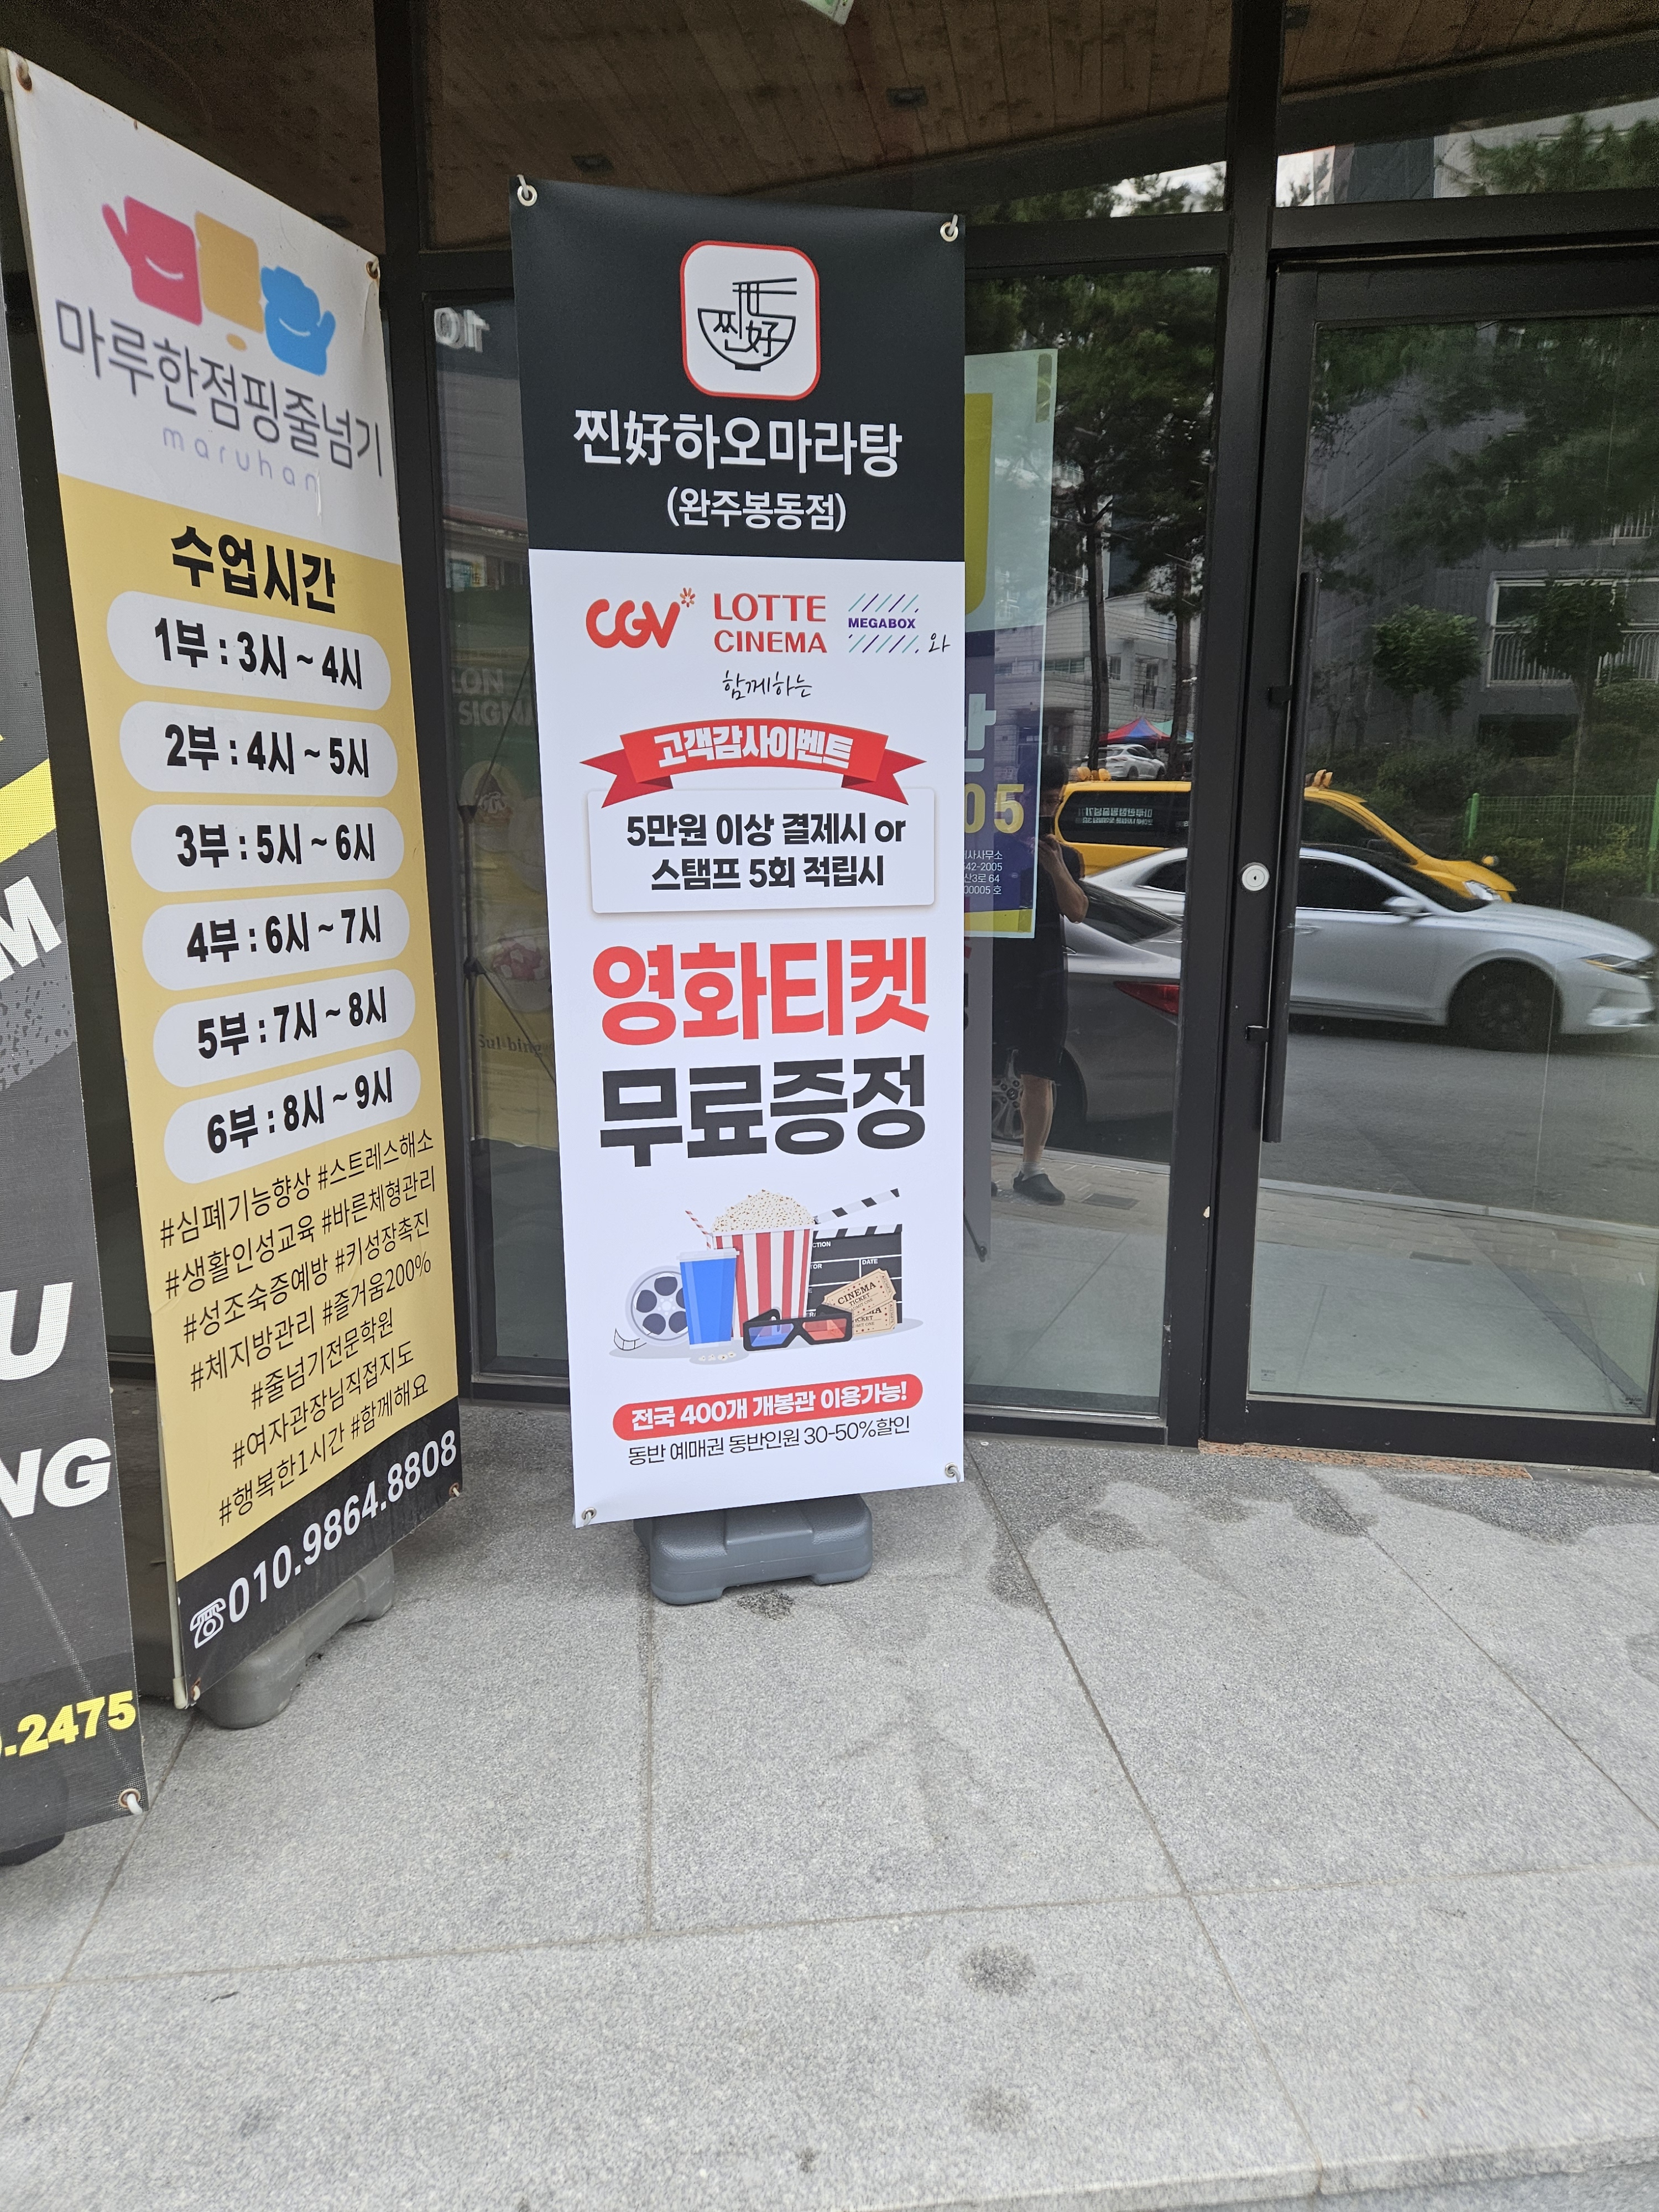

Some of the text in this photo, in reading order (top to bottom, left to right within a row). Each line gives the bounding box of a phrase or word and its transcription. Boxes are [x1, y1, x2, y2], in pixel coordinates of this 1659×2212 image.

[55, 299, 383, 478] 마루한점핑줄넘기
[163, 427, 319, 493] maruhan
[573, 409, 903, 477] 찐好하오마라탕
[667, 487, 847, 532] (완주봉동점)
[171, 525, 336, 613] 수업시간
[586, 598, 681, 649] CGV
[714, 593, 826, 623] LOTTE
[848, 617, 916, 629] MEGABOX
[714, 630, 828, 654] CINEMA
[722, 669, 813, 701] 함께하는
[654, 725, 854, 769] 고객감사이벤트
[627, 812, 906, 847] 5만원 이상 결제시 or
[651, 855, 885, 891] 스탬프 5회 적립시
[988, 874, 1000, 883] 64
[993, 885, 1002, 895] 호
[592, 936, 930, 1046] 영화티켓
[600, 1054, 926, 1167] 무료증정
[160, 1129, 434, 1249] #심폐기능향상 #스트레스해소
[165, 1165, 435, 1300] #생활인성교육 #바른체형관리
[183, 1208, 430, 1344] #성조숙증예방 #키성장촉진
[837, 1282, 877, 1305] CINEMA
[849, 1292, 870, 1307] TICKET
[190, 1251, 431, 1392] #체지방관리 #즐거움200%
[251, 1307, 393, 1410] #줄넘기전문학원
[232, 1340, 414, 1469] #여자관장님직접지도
[632, 1381, 907, 1431] 전국 400개 개봉관 이용가능!
[218, 1373, 429, 1527] #행복한1시간 #함께해요
[628, 1444, 666, 1466] 동반
[670, 1437, 724, 1460] 예매권
[729, 1427, 800, 1454] 동반인원
[228, 1431, 457, 1624] 010.9864.8808
[0, 1690, 136, 1758] .2475
